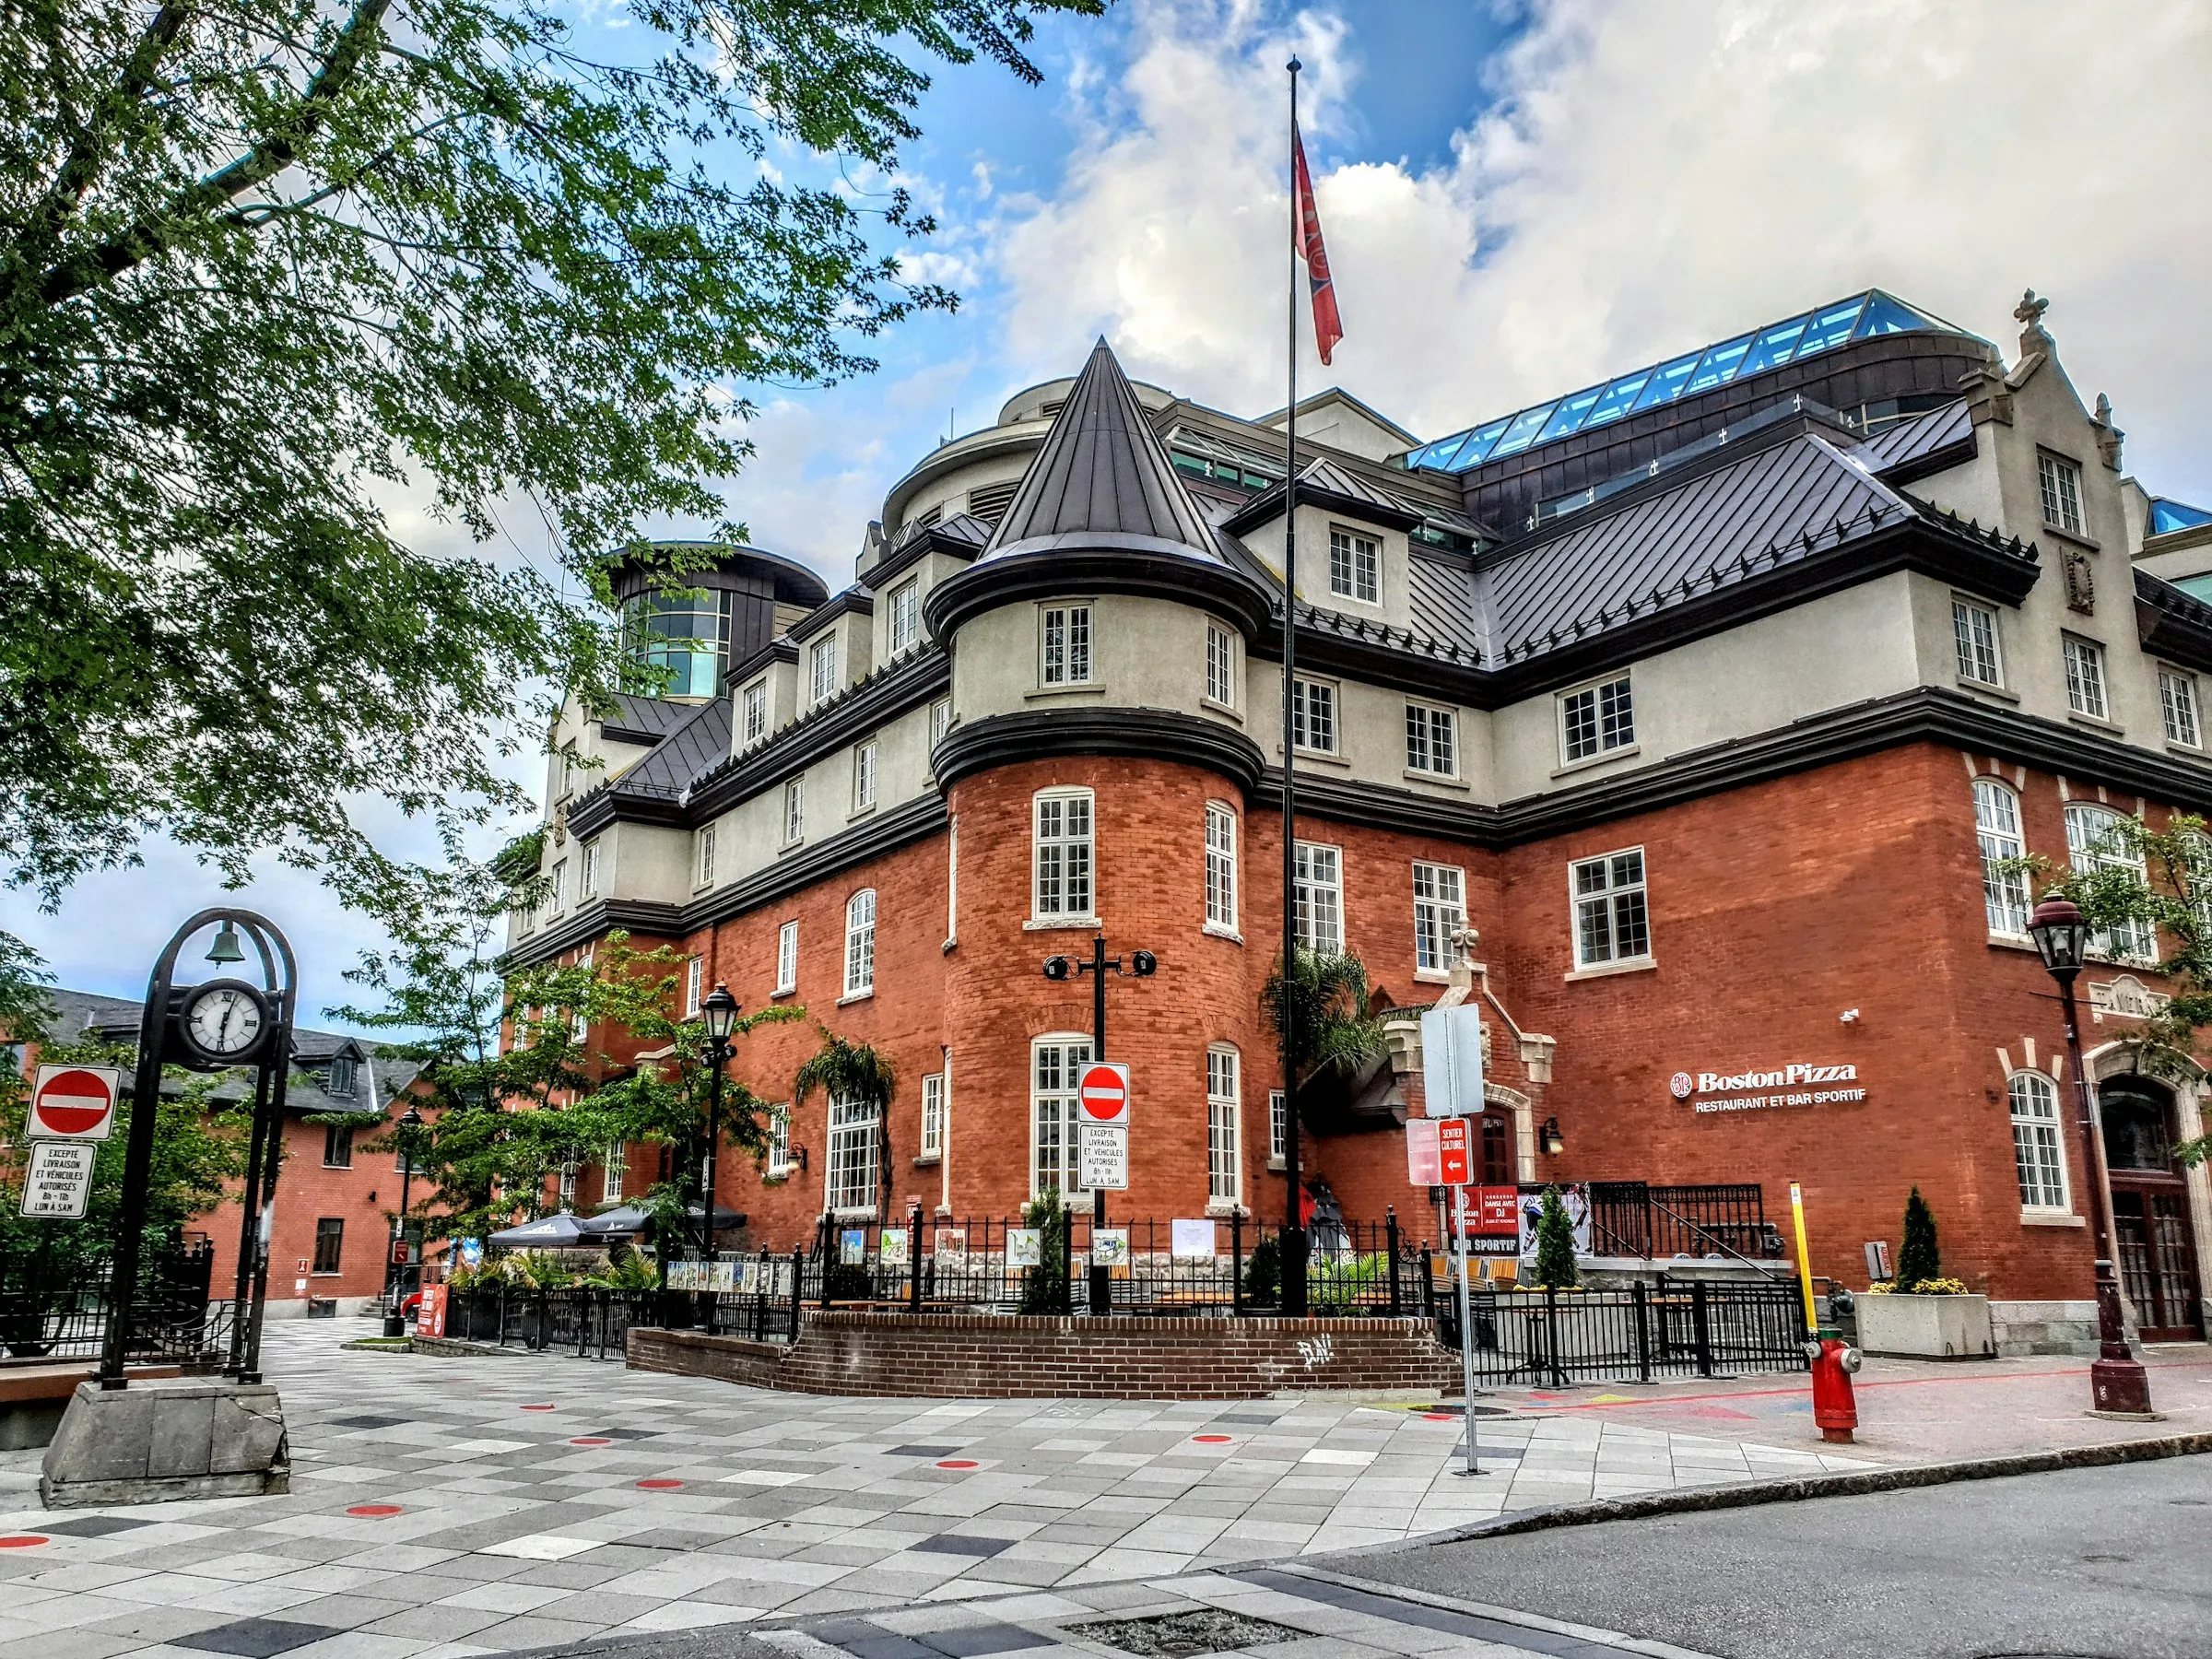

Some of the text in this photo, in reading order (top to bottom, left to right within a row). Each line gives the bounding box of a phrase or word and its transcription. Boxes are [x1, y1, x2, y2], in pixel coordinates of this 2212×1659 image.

[1697, 1063, 1857, 1093] Boston Pizza
[1696, 1088, 1866, 1113] RESTAURANT ET BAR SPORTIF
[1441, 1127, 1464, 1138] SENTIER
[1088, 1138, 1117, 1147] LIVRAISON
[1441, 1139, 1465, 1150] CULTUREL
[49, 1148, 78, 1159] EXCEPTÉ
[1084, 1147, 1090, 1156] ET
[42, 1159, 80, 1169] LIVRAISON
[36, 1170, 84, 1181] ET VÉHICULES
[1086, 1176, 1097, 1184] LUN
[1107, 1177, 1120, 1185] SAM
[39, 1182, 77, 1192] AUTORISÉS
[34, 1202, 49, 1211] LUN
[57, 1203, 73, 1212] SAM
[1496, 1207, 1505, 1218] DJ
[1451, 1209, 1479, 1218] Bston
[1453, 1239, 1517, 1252] BR SPORTIF
